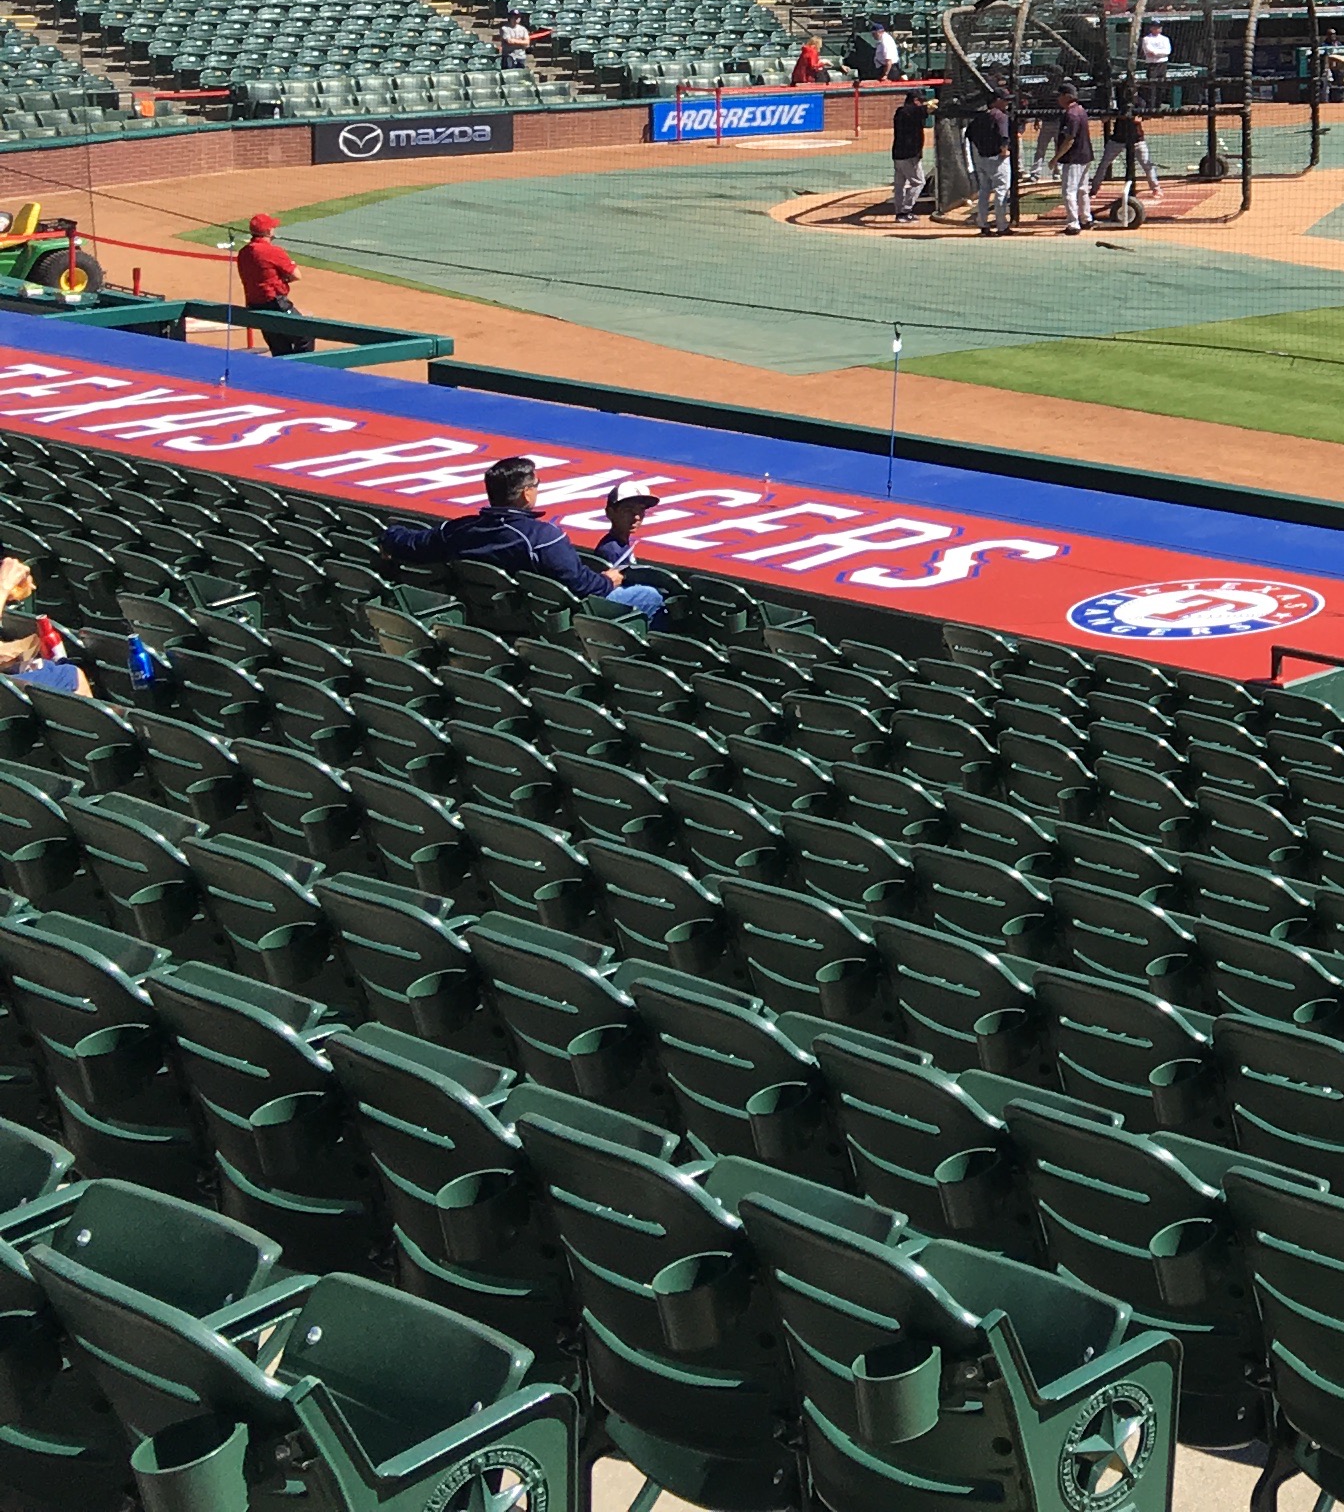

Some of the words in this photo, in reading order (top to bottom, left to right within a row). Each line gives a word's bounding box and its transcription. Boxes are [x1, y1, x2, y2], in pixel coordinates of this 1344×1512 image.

[660, 103, 811, 134] PROGRESSIVE
[1180, 581, 1308, 611] TEXAS
[1084, 598, 1252, 637] RANGERS
